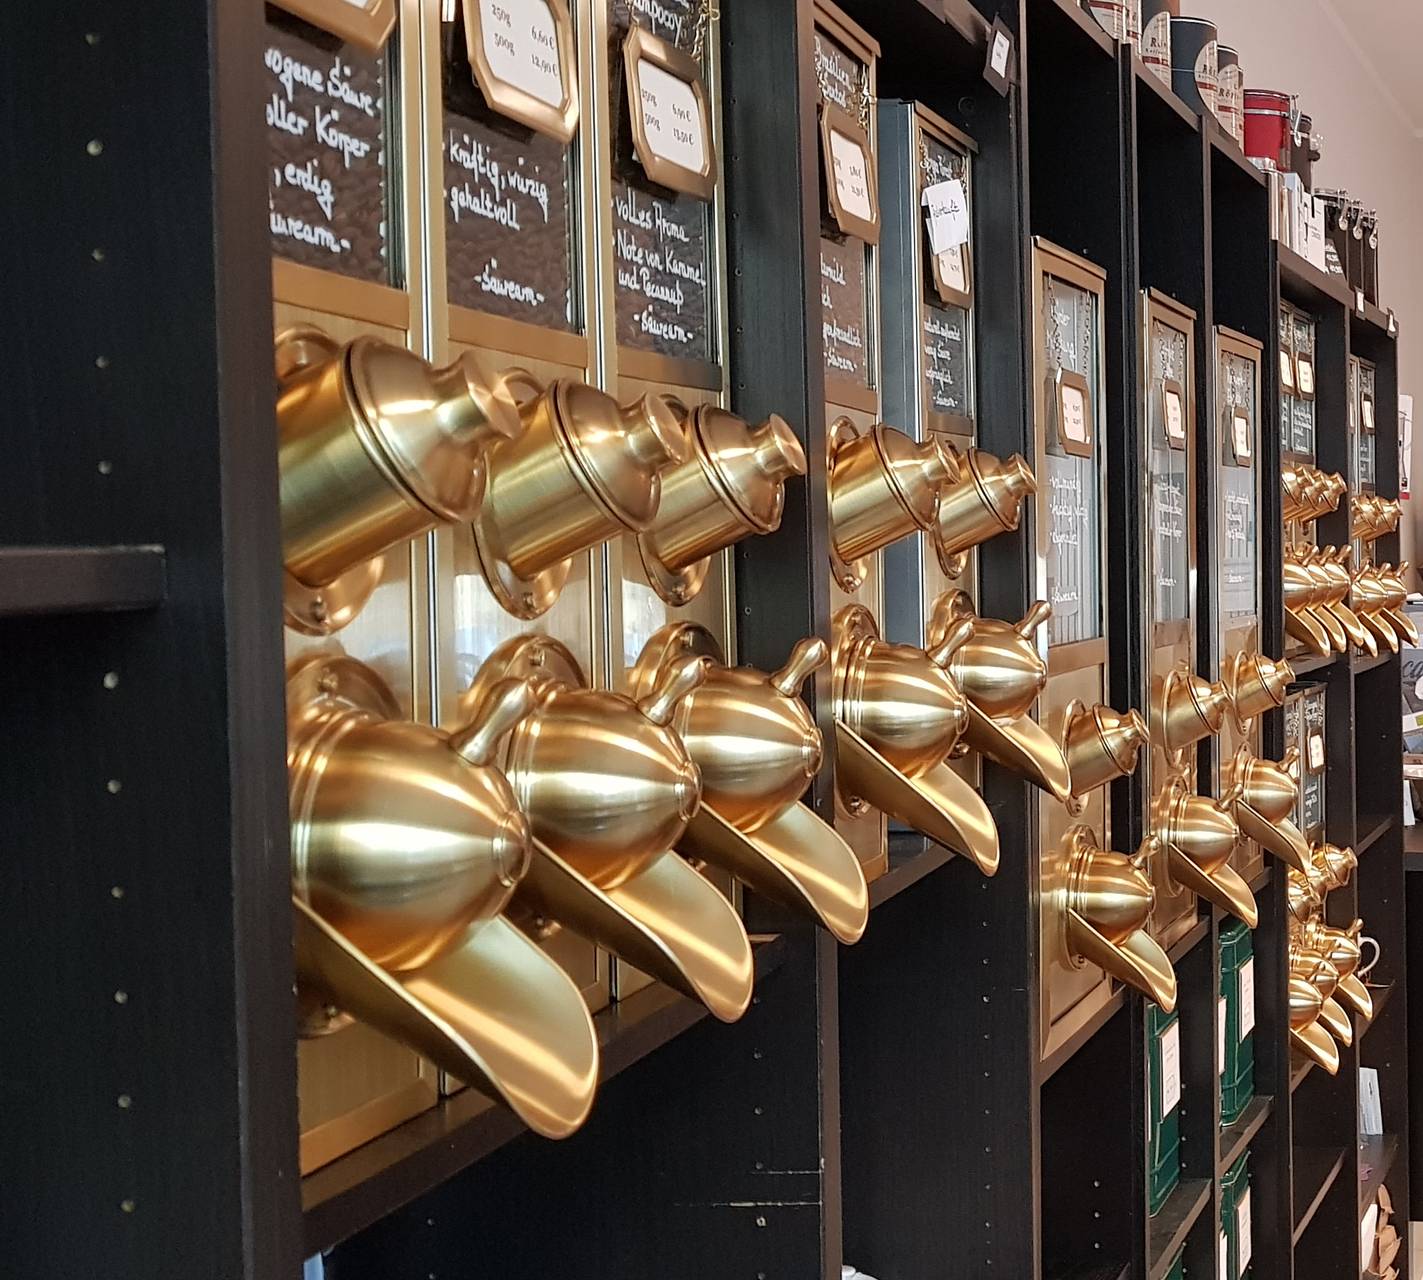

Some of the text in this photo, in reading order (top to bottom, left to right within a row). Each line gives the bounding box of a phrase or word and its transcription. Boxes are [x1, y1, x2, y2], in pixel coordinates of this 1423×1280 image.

[315, 105, 371, 168] Körper
[451, 182, 521, 231] gehaltvoll
[616, 187, 690, 242] volles Aroma
[617, 228, 643, 265] Note
[618, 265, 641, 291] und
